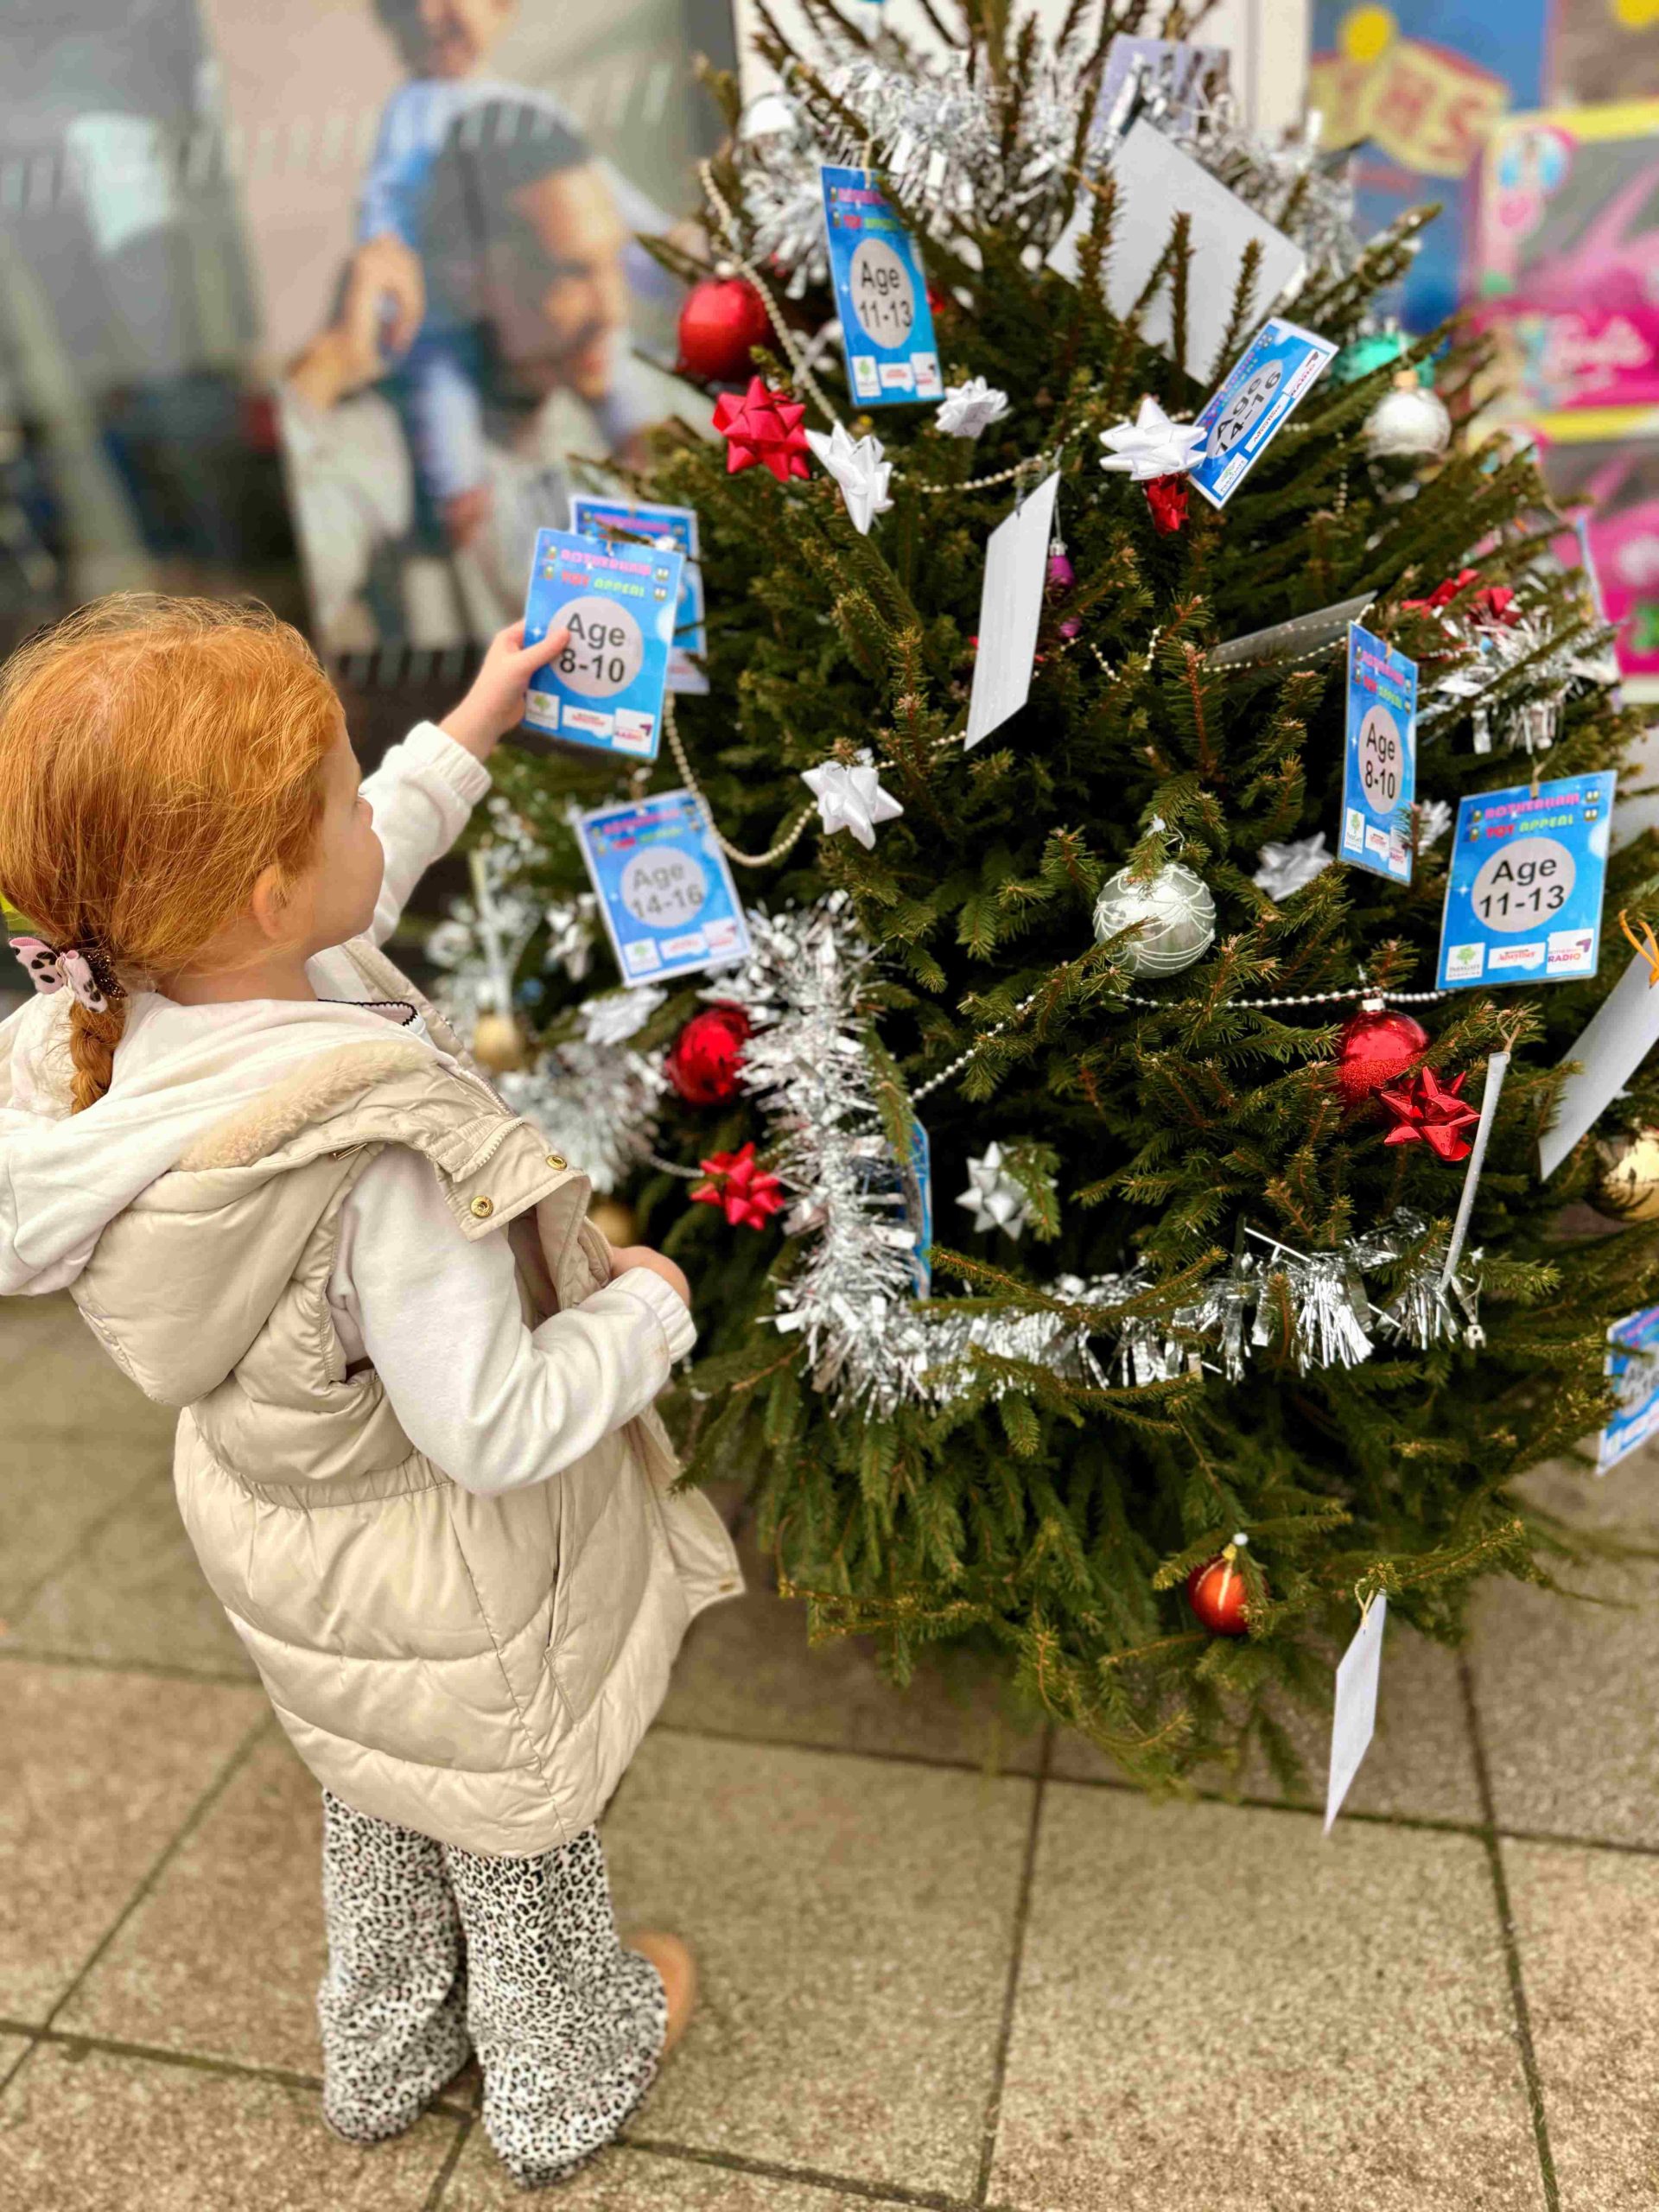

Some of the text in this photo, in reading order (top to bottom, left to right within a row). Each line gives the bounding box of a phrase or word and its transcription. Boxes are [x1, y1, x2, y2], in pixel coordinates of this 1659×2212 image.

[861, 261, 900, 296] Age
[858, 300, 912, 329] 11-13
[1214, 371, 1281, 456] 14-16
[1216, 378, 1262, 442] Age
[567, 613, 625, 650] Age
[559, 649, 625, 683] 8-10
[1366, 722, 1395, 763] Age
[1365, 760, 1395, 799] 8-10
[1486, 823, 1516, 838] TOY
[632, 863, 683, 891] Age
[1491, 858, 1557, 887] Age
[632, 883, 703, 918] 14-16
[1478, 885, 1565, 918] 11-13
[1548, 952, 1581, 963] RADIO
